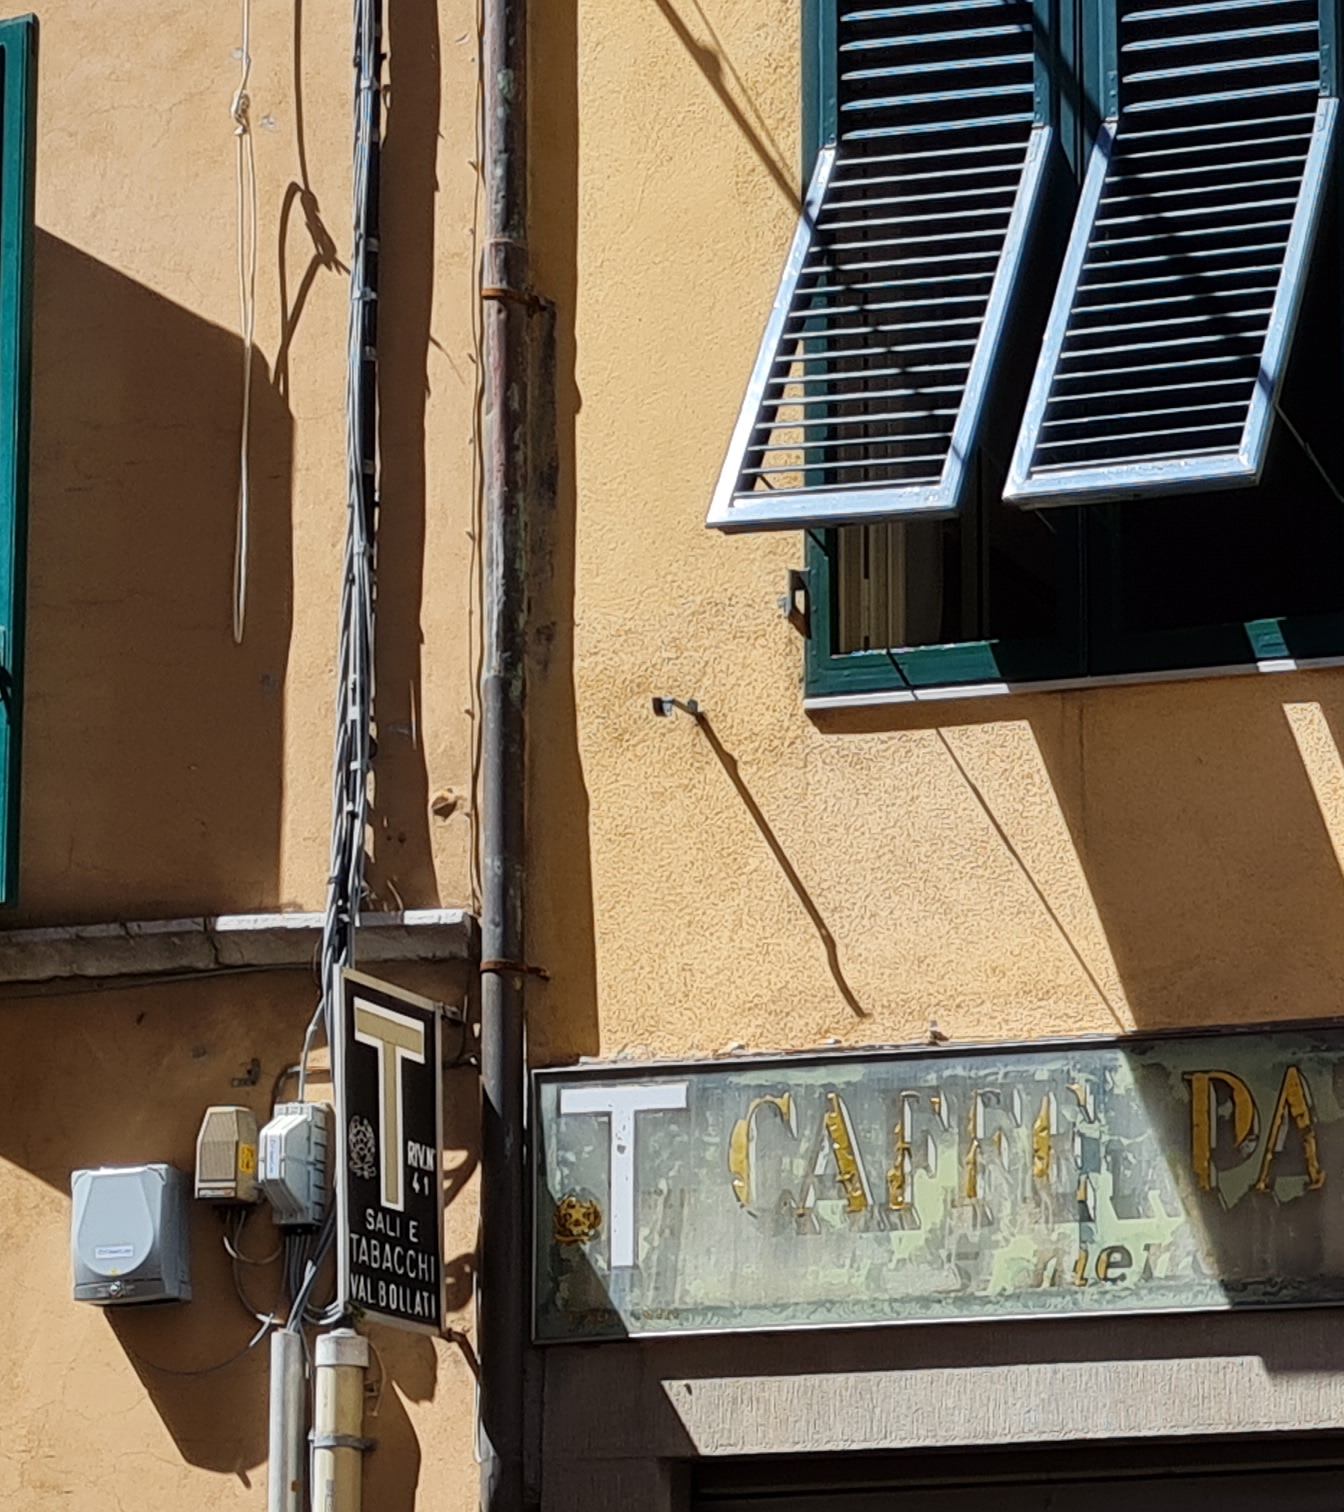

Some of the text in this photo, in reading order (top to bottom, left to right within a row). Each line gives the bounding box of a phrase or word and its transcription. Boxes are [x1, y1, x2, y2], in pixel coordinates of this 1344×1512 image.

[353, 997, 425, 1211] T
[412, 1171, 429, 1196] 41
[560, 1082, 689, 1268] T
[365, 1208, 419, 1243] SALI E
[350, 1233, 435, 1284] TABACCHI
[350, 1273, 435, 1319] VAL BOLLATI
